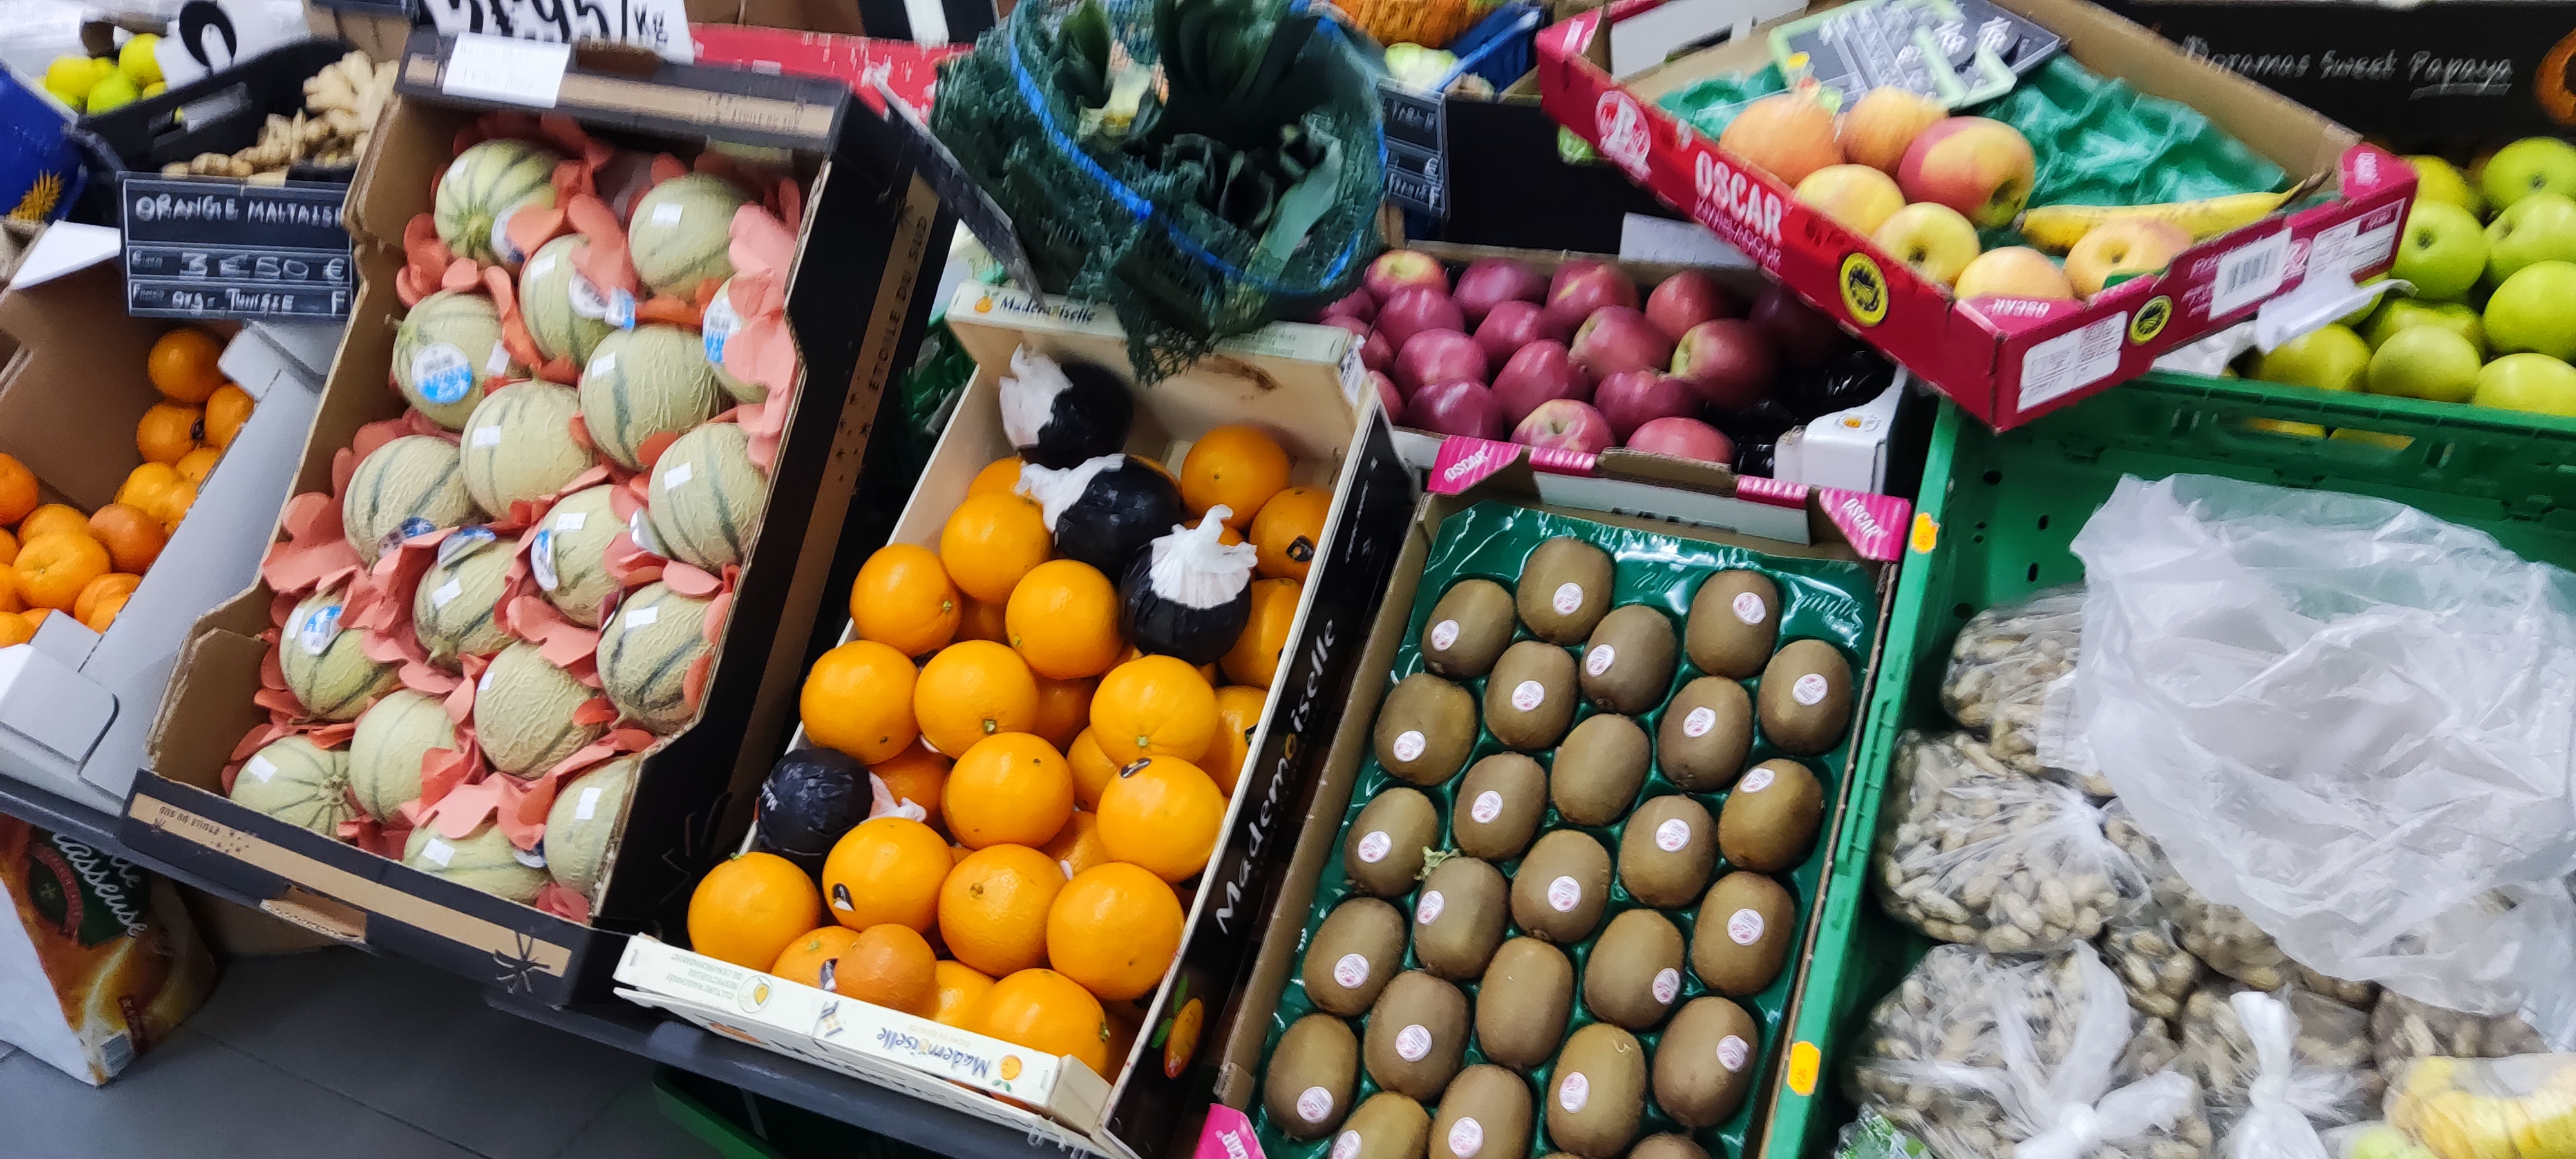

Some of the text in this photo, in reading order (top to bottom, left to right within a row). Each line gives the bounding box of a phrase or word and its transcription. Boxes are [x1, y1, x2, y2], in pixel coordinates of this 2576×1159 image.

[2318, 49, 2399, 80] Sweet
[2407, 50, 2514, 93] Papaya
[135, 193, 239, 222] ORANGE
[1695, 150, 1784, 247] OSCAR
[907, 215, 928, 262] SUD
[1444, 449, 1487, 484] OSCAR
[1842, 497, 1882, 540] OSCAR
[1215, 617, 1338, 936] Mademoiselle
[876, 1026, 992, 1080] Mademoiselle
